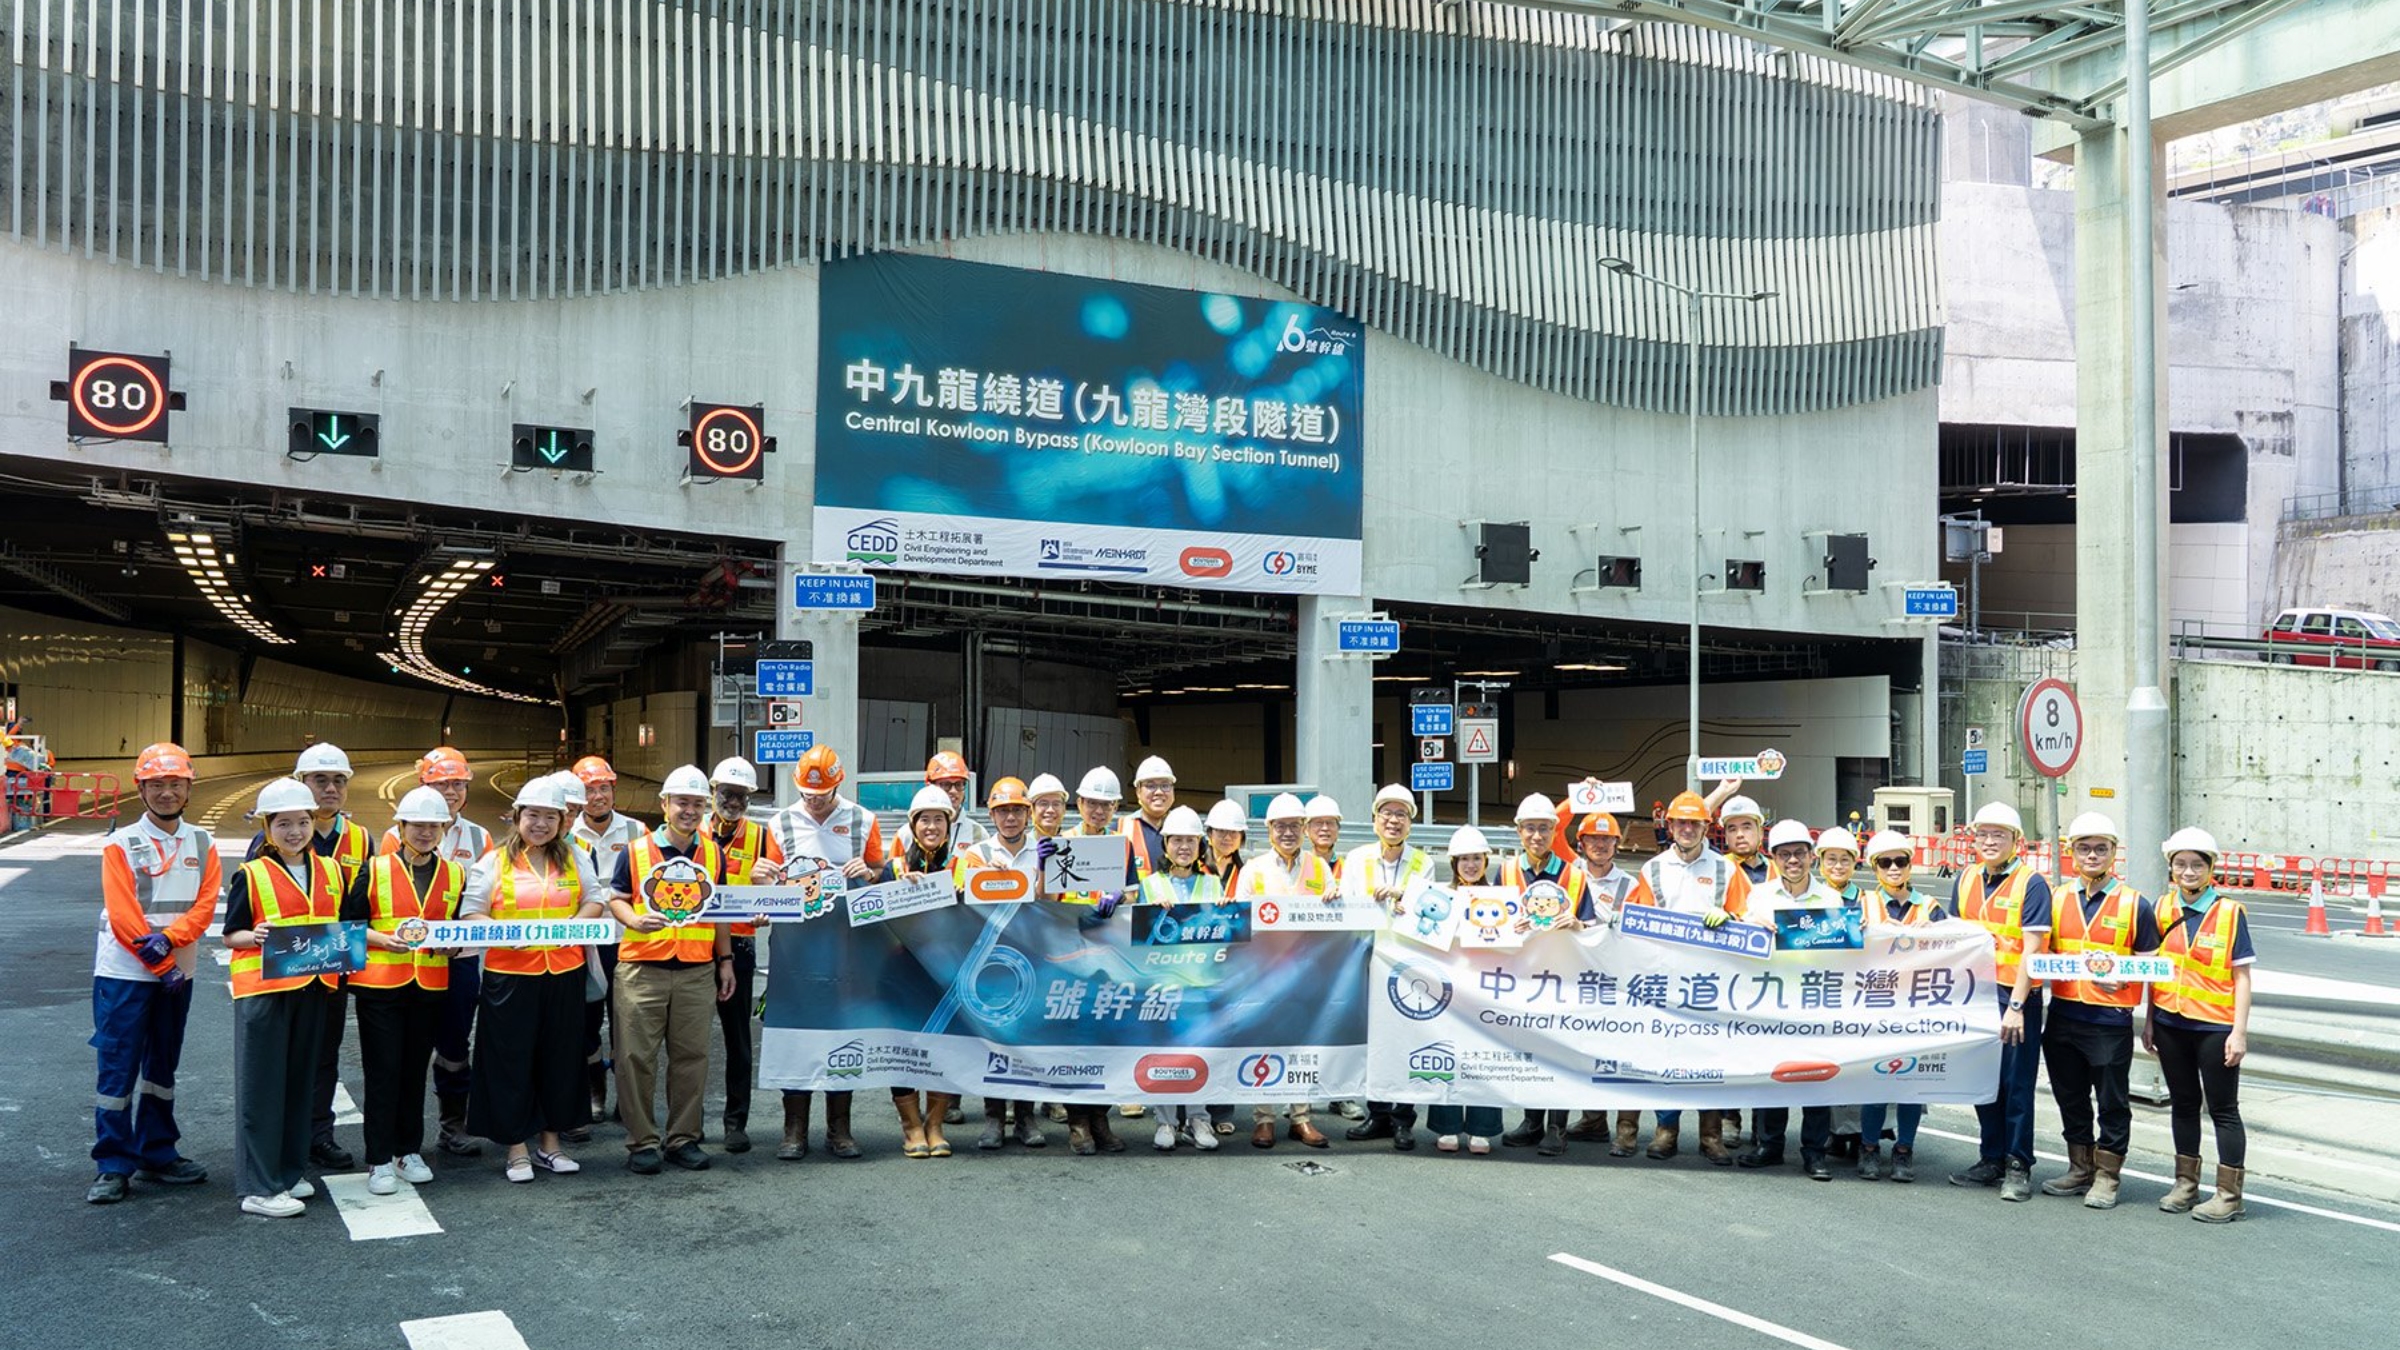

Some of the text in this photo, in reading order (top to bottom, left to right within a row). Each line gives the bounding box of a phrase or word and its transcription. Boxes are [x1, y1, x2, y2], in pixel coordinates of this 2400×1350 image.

[92, 380, 146, 410] 80
[846, 358, 1340, 444] 中九龍繞道(九龍灣段隧道)
[708, 428, 748, 453] 80
[846, 411, 1340, 473] Central Kowloon Bypass (Kowloon Bay Section Tunnel)
[847, 534, 898, 552] CEDD
[905, 530, 983, 545] 土木工程拓展署
[904, 543, 988, 556] Civil Engineering and
[1095, 548, 1147, 560] MEINHARDT
[904, 554, 1003, 567] Development Department
[1297, 565, 1317, 575] BYME
[799, 578, 870, 589] KEEP IN LANE
[1342, 625, 1395, 633] KEEP IN LANE
[760, 663, 811, 671] Turn On Radio
[2046, 698, 2060, 727] 8
[2035, 732, 2073, 751] km/h
[1701, 761, 1756, 775] 利民便民
[753, 897, 801, 907] MEINHARDT
[851, 899, 884, 915] CEDD
[1288, 912, 1343, 923] 運輸及物流局
[434, 923, 610, 942] 中九龍繞道(九龍灣段)
[1181, 925, 1226, 942] 號幹線
[1794, 936, 1844, 947] City Connected
[1146, 948, 1227, 966] Route 6
[286, 960, 342, 974] Minutes Away
[2033, 959, 2169, 976] 惠民生 添幸福
[1479, 966, 1975, 1011] 中九龍繞道(九龍灣段)
[1044, 979, 1185, 1022] 號幹線
[1479, 1010, 1967, 1038] Central Kowloon Bypass (Kowloon Bay Section)
[828, 1053, 864, 1068] CEDD
[880, 1057, 917, 1067] Engineering
[1409, 1055, 1455, 1071] CEDD
[1918, 1063, 1946, 1072] BYME
[867, 1066, 943, 1077] Development Department
[1047, 1065, 1105, 1076] MEINHARDT
[1461, 1063, 1477, 1071] Civil
[1479, 1063, 1523, 1073] Engineering
[1661, 1068, 1724, 1080] MEINHARDT
[1287, 1071, 1319, 1084] BYME
[1461, 1072, 1554, 1083] Development Department
